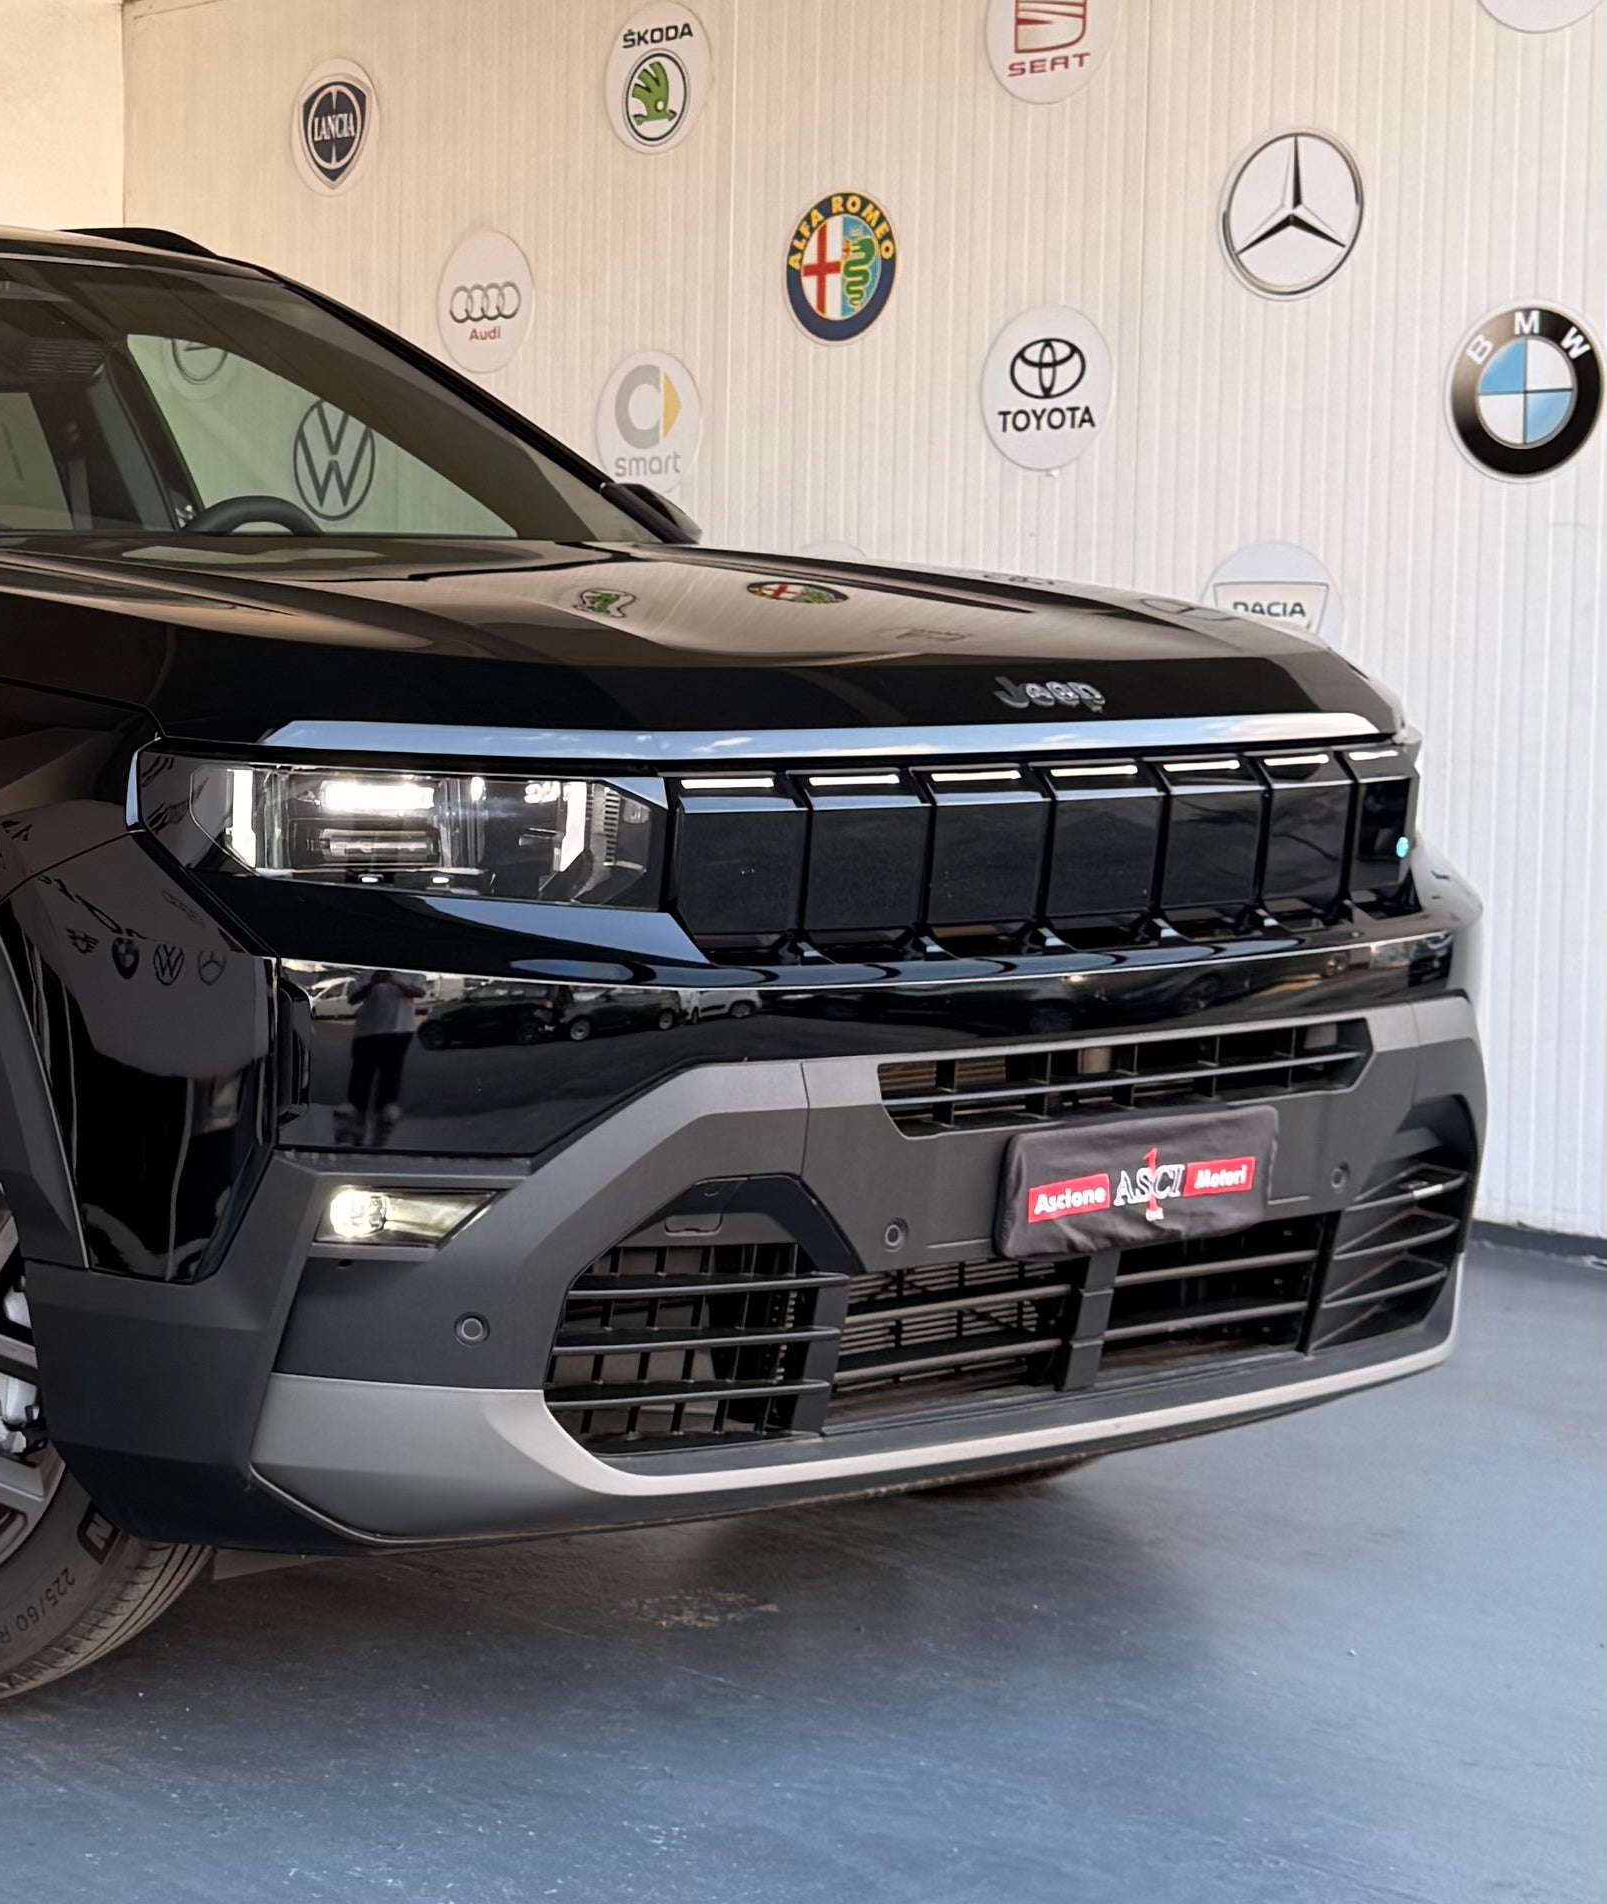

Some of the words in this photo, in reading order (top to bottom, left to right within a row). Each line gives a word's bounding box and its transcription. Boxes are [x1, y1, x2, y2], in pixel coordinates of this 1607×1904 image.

[622, 22, 694, 49] ŠKODA
[1007, 52, 1092, 78] SEAT
[312, 111, 356, 142] LANCIA
[786, 208, 824, 271] ALFA
[830, 195, 894, 261] ROMEO
[469, 326, 501, 341] Audi
[1466, 310, 1591, 364] BMW
[997, 404, 1096, 434] TOYOTA
[614, 452, 681, 478] smart
[1233, 601, 1306, 618] DACIA
[994, 675, 1106, 713] Jeep
[1034, 1186, 1107, 1214] Ascione
[1113, 1164, 1186, 1206] ASCI
[1194, 1164, 1248, 1190] Motori
